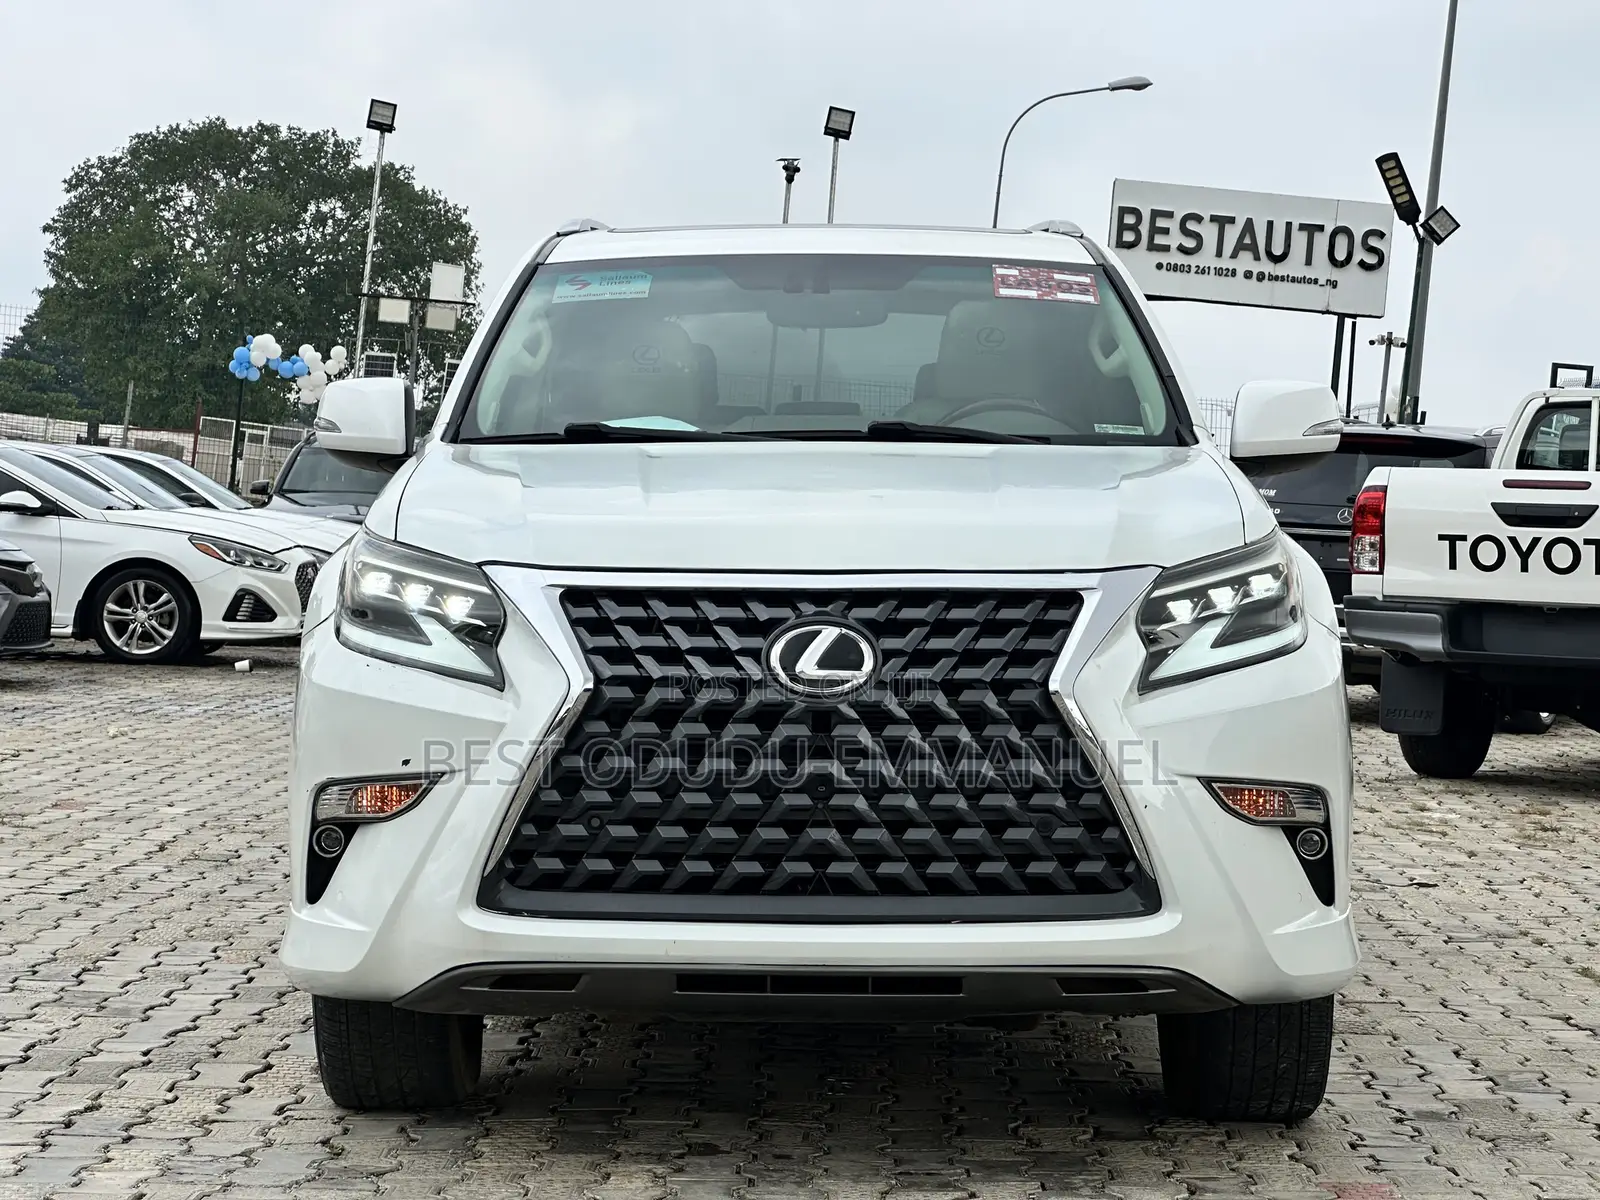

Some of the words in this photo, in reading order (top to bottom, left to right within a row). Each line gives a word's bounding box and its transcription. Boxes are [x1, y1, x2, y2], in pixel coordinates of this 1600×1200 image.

[1115, 205, 1387, 271] BESTAUTOS
[1165, 262, 1192, 274] 0803
[1194, 265, 1211, 276] 261
[1213, 266, 1237, 278] 1028
[1437, 533, 1600, 575] TOYOT
[1385, 708, 1434, 720] HILUX
